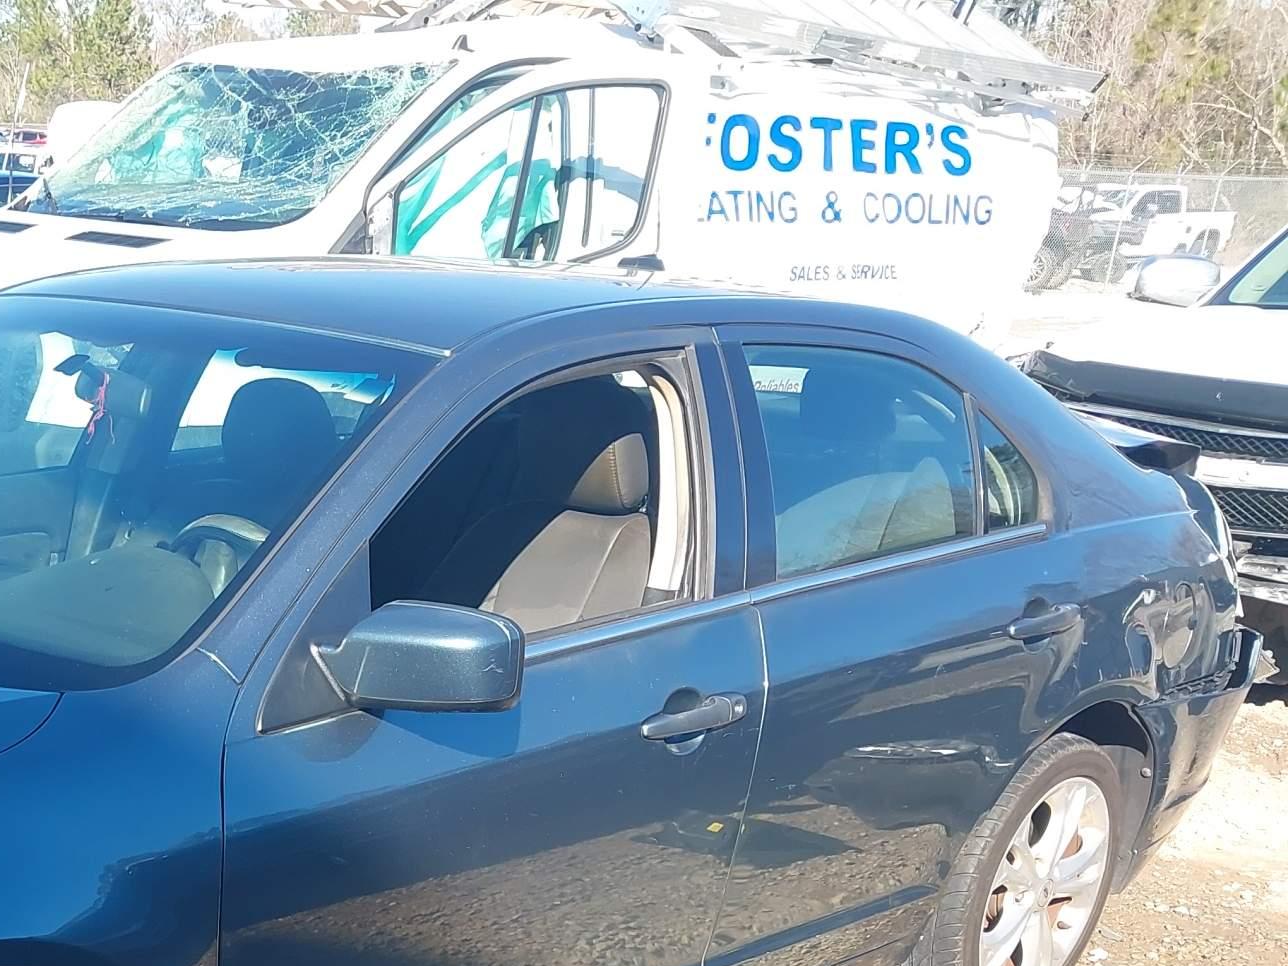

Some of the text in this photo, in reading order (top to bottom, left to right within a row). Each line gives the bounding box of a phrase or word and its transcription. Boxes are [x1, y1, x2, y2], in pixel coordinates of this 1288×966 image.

[705, 112, 971, 177] OSTER'S
[821, 190, 842, 224] &
[864, 191, 993, 225] COOLING
[790, 263, 897, 282] SALES & SERVICE
